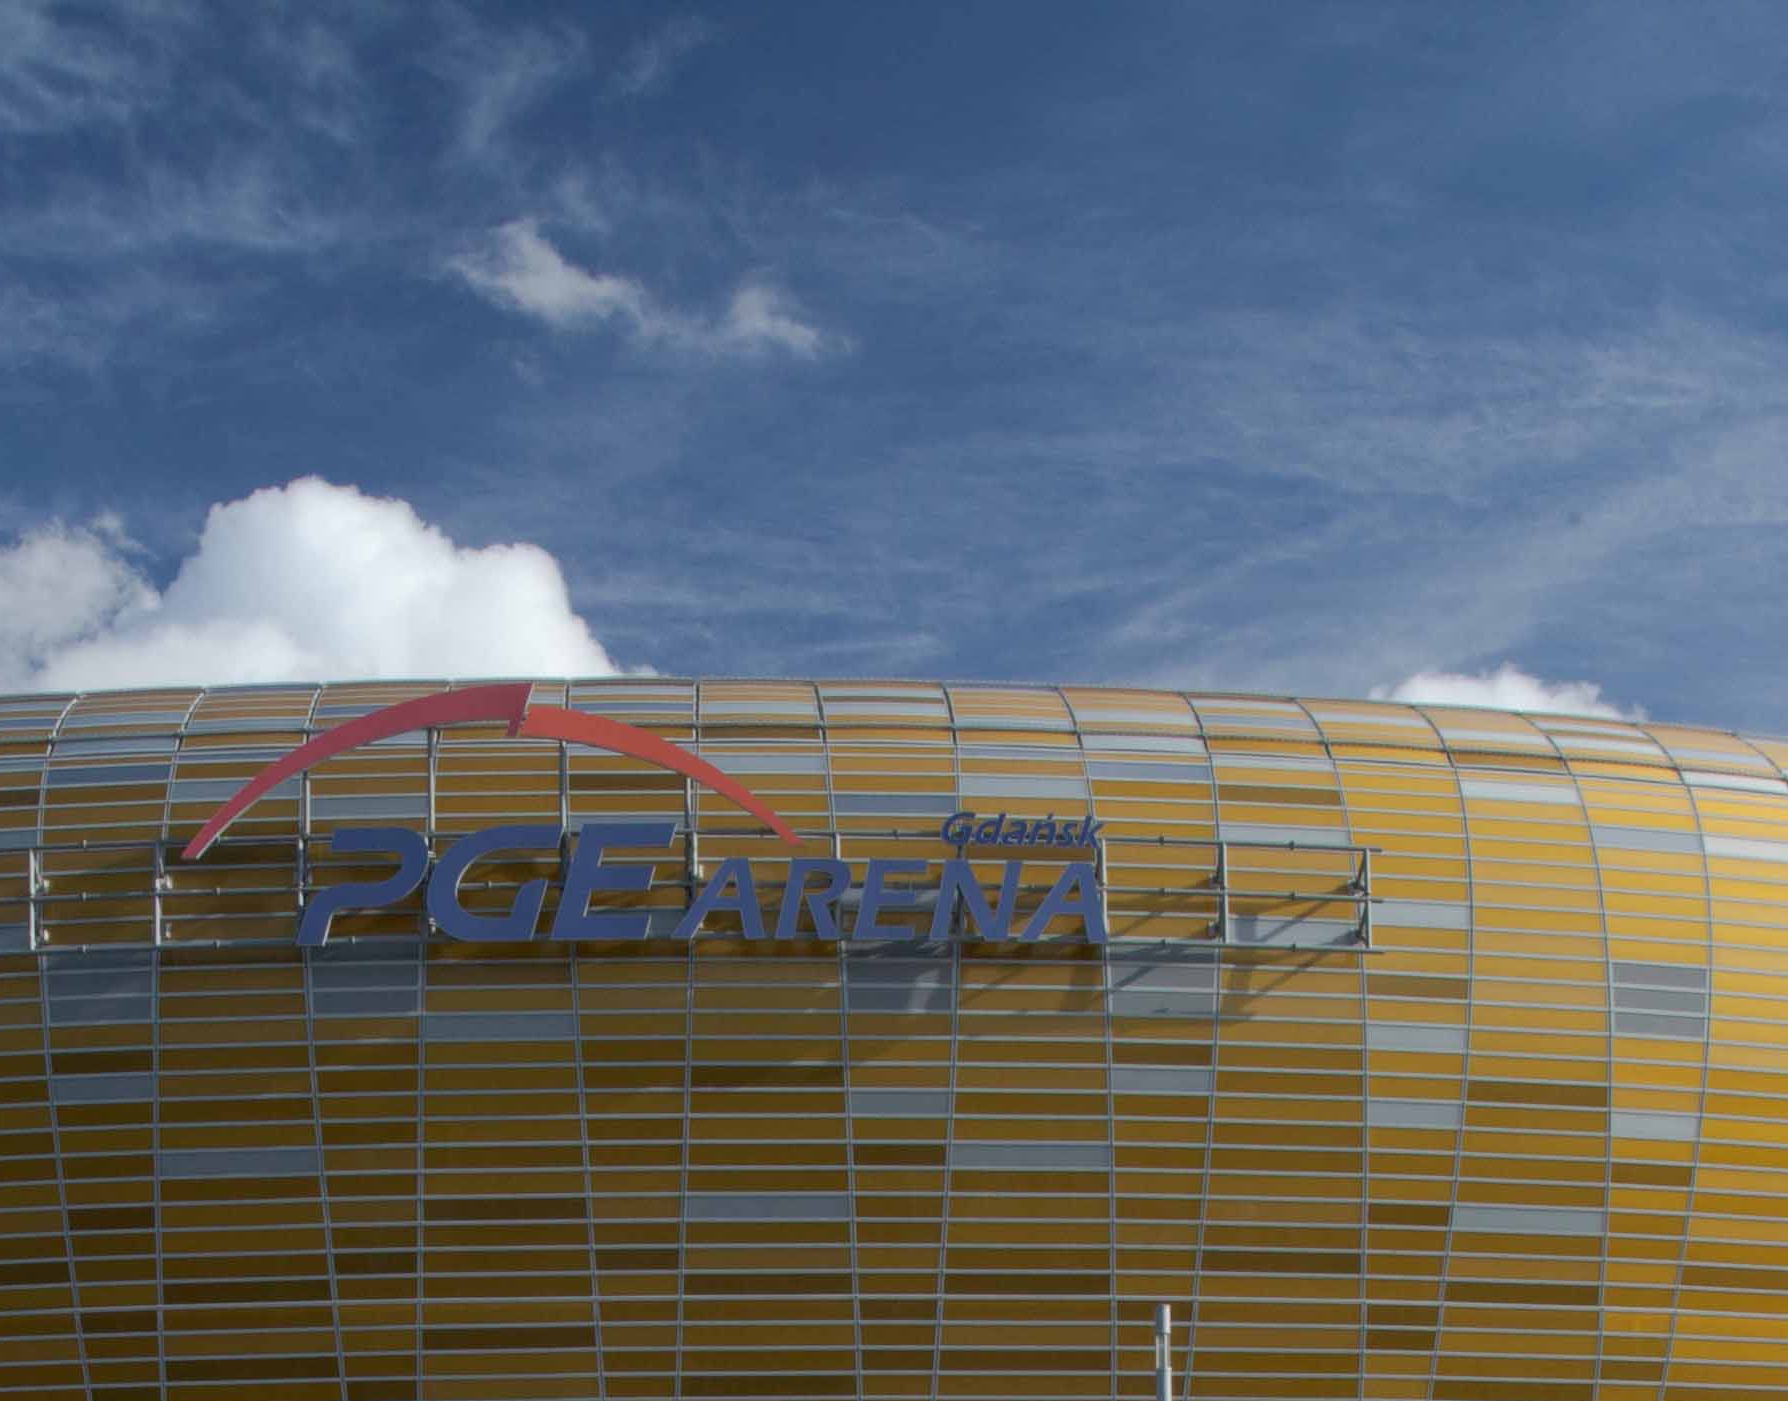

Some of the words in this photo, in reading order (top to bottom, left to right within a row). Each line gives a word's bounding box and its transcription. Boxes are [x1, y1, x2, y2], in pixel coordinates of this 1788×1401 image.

[941, 812, 1103, 849] Gdańsk
[296, 823, 677, 946] PGE
[671, 857, 1109, 944] ARENA
